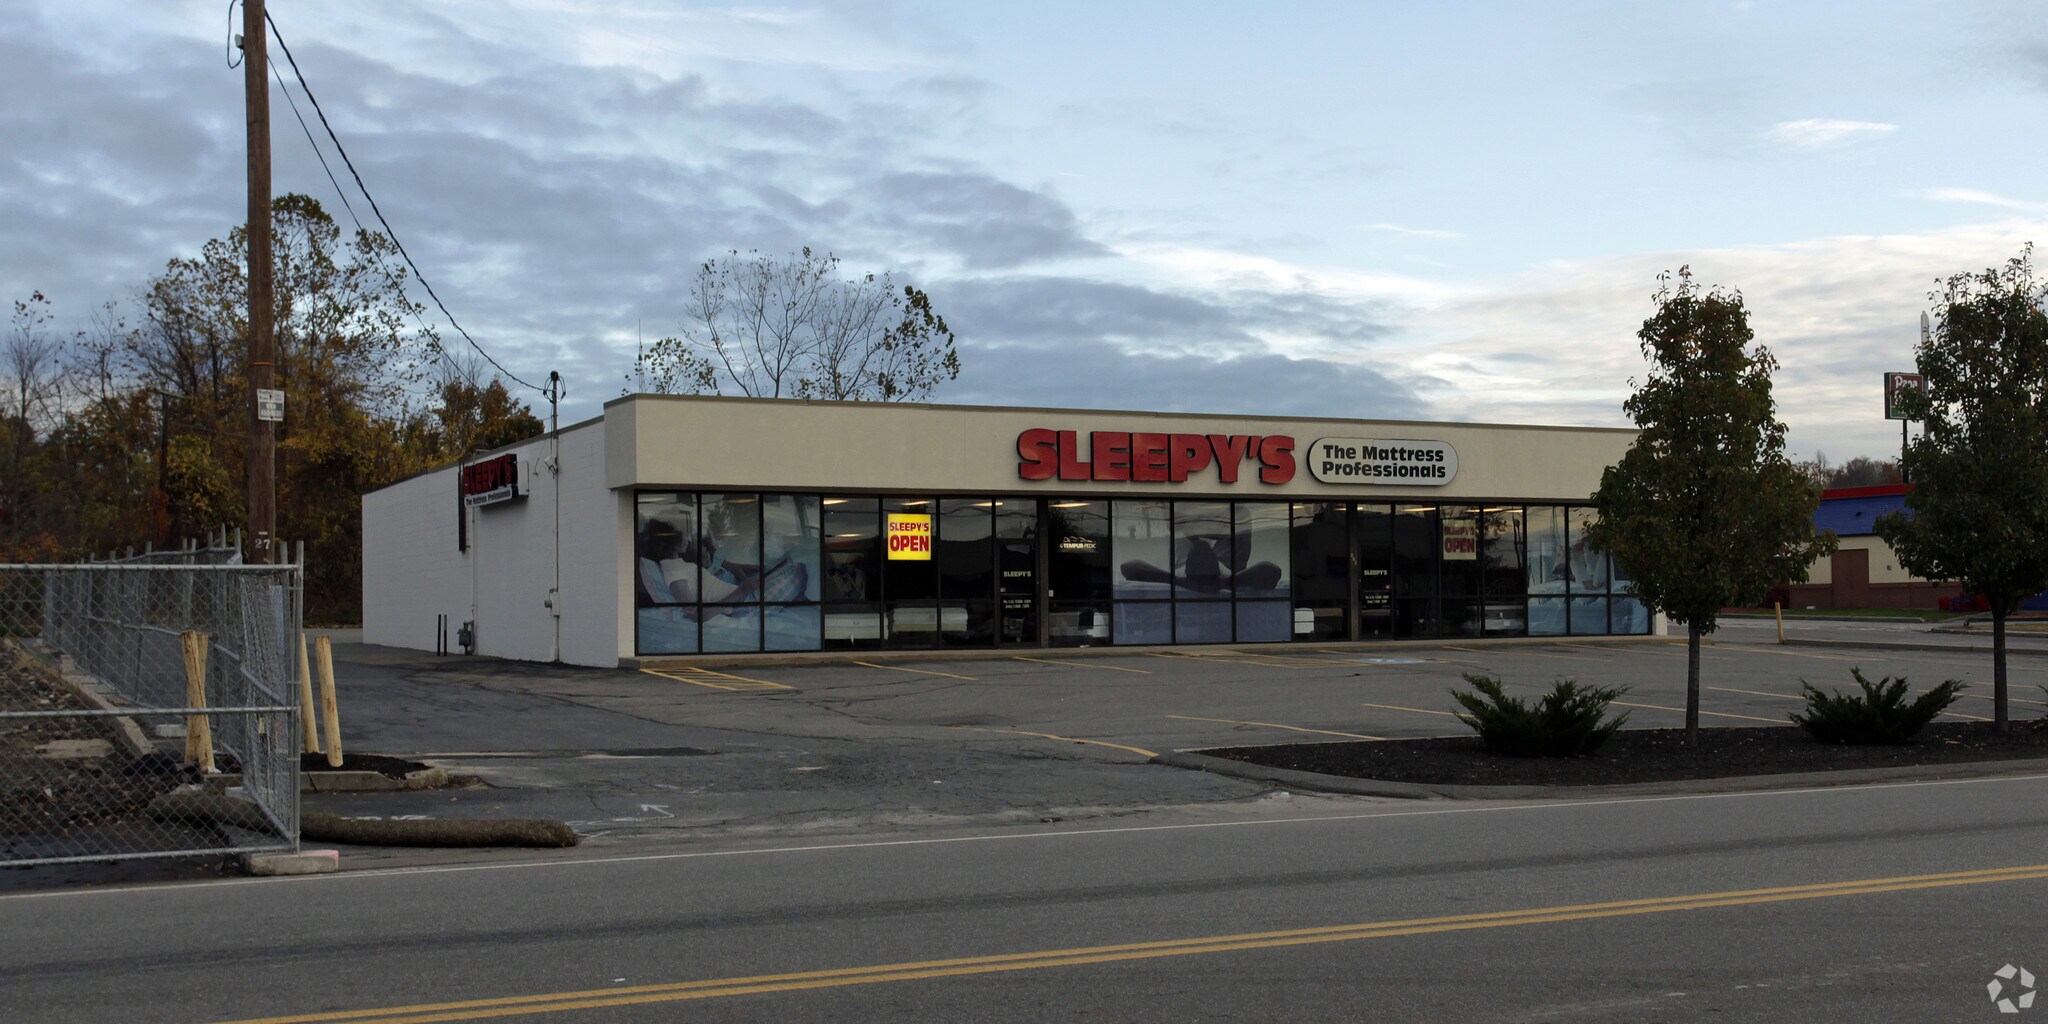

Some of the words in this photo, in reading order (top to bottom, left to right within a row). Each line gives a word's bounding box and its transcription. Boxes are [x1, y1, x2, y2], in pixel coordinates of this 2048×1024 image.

[1017, 428, 1297, 485] SLEEPY'S
[1323, 445, 1356, 459] The
[1362, 446, 1444, 462] Mattress
[464, 454, 512, 495] SLEEPY'S
[1322, 461, 1446, 478] Professionals
[890, 522, 929, 531] SLEEPY'S
[255, 538, 270, 550] 27
[890, 535, 929, 552] OPEN
[1445, 537, 1475, 553] OPEN
